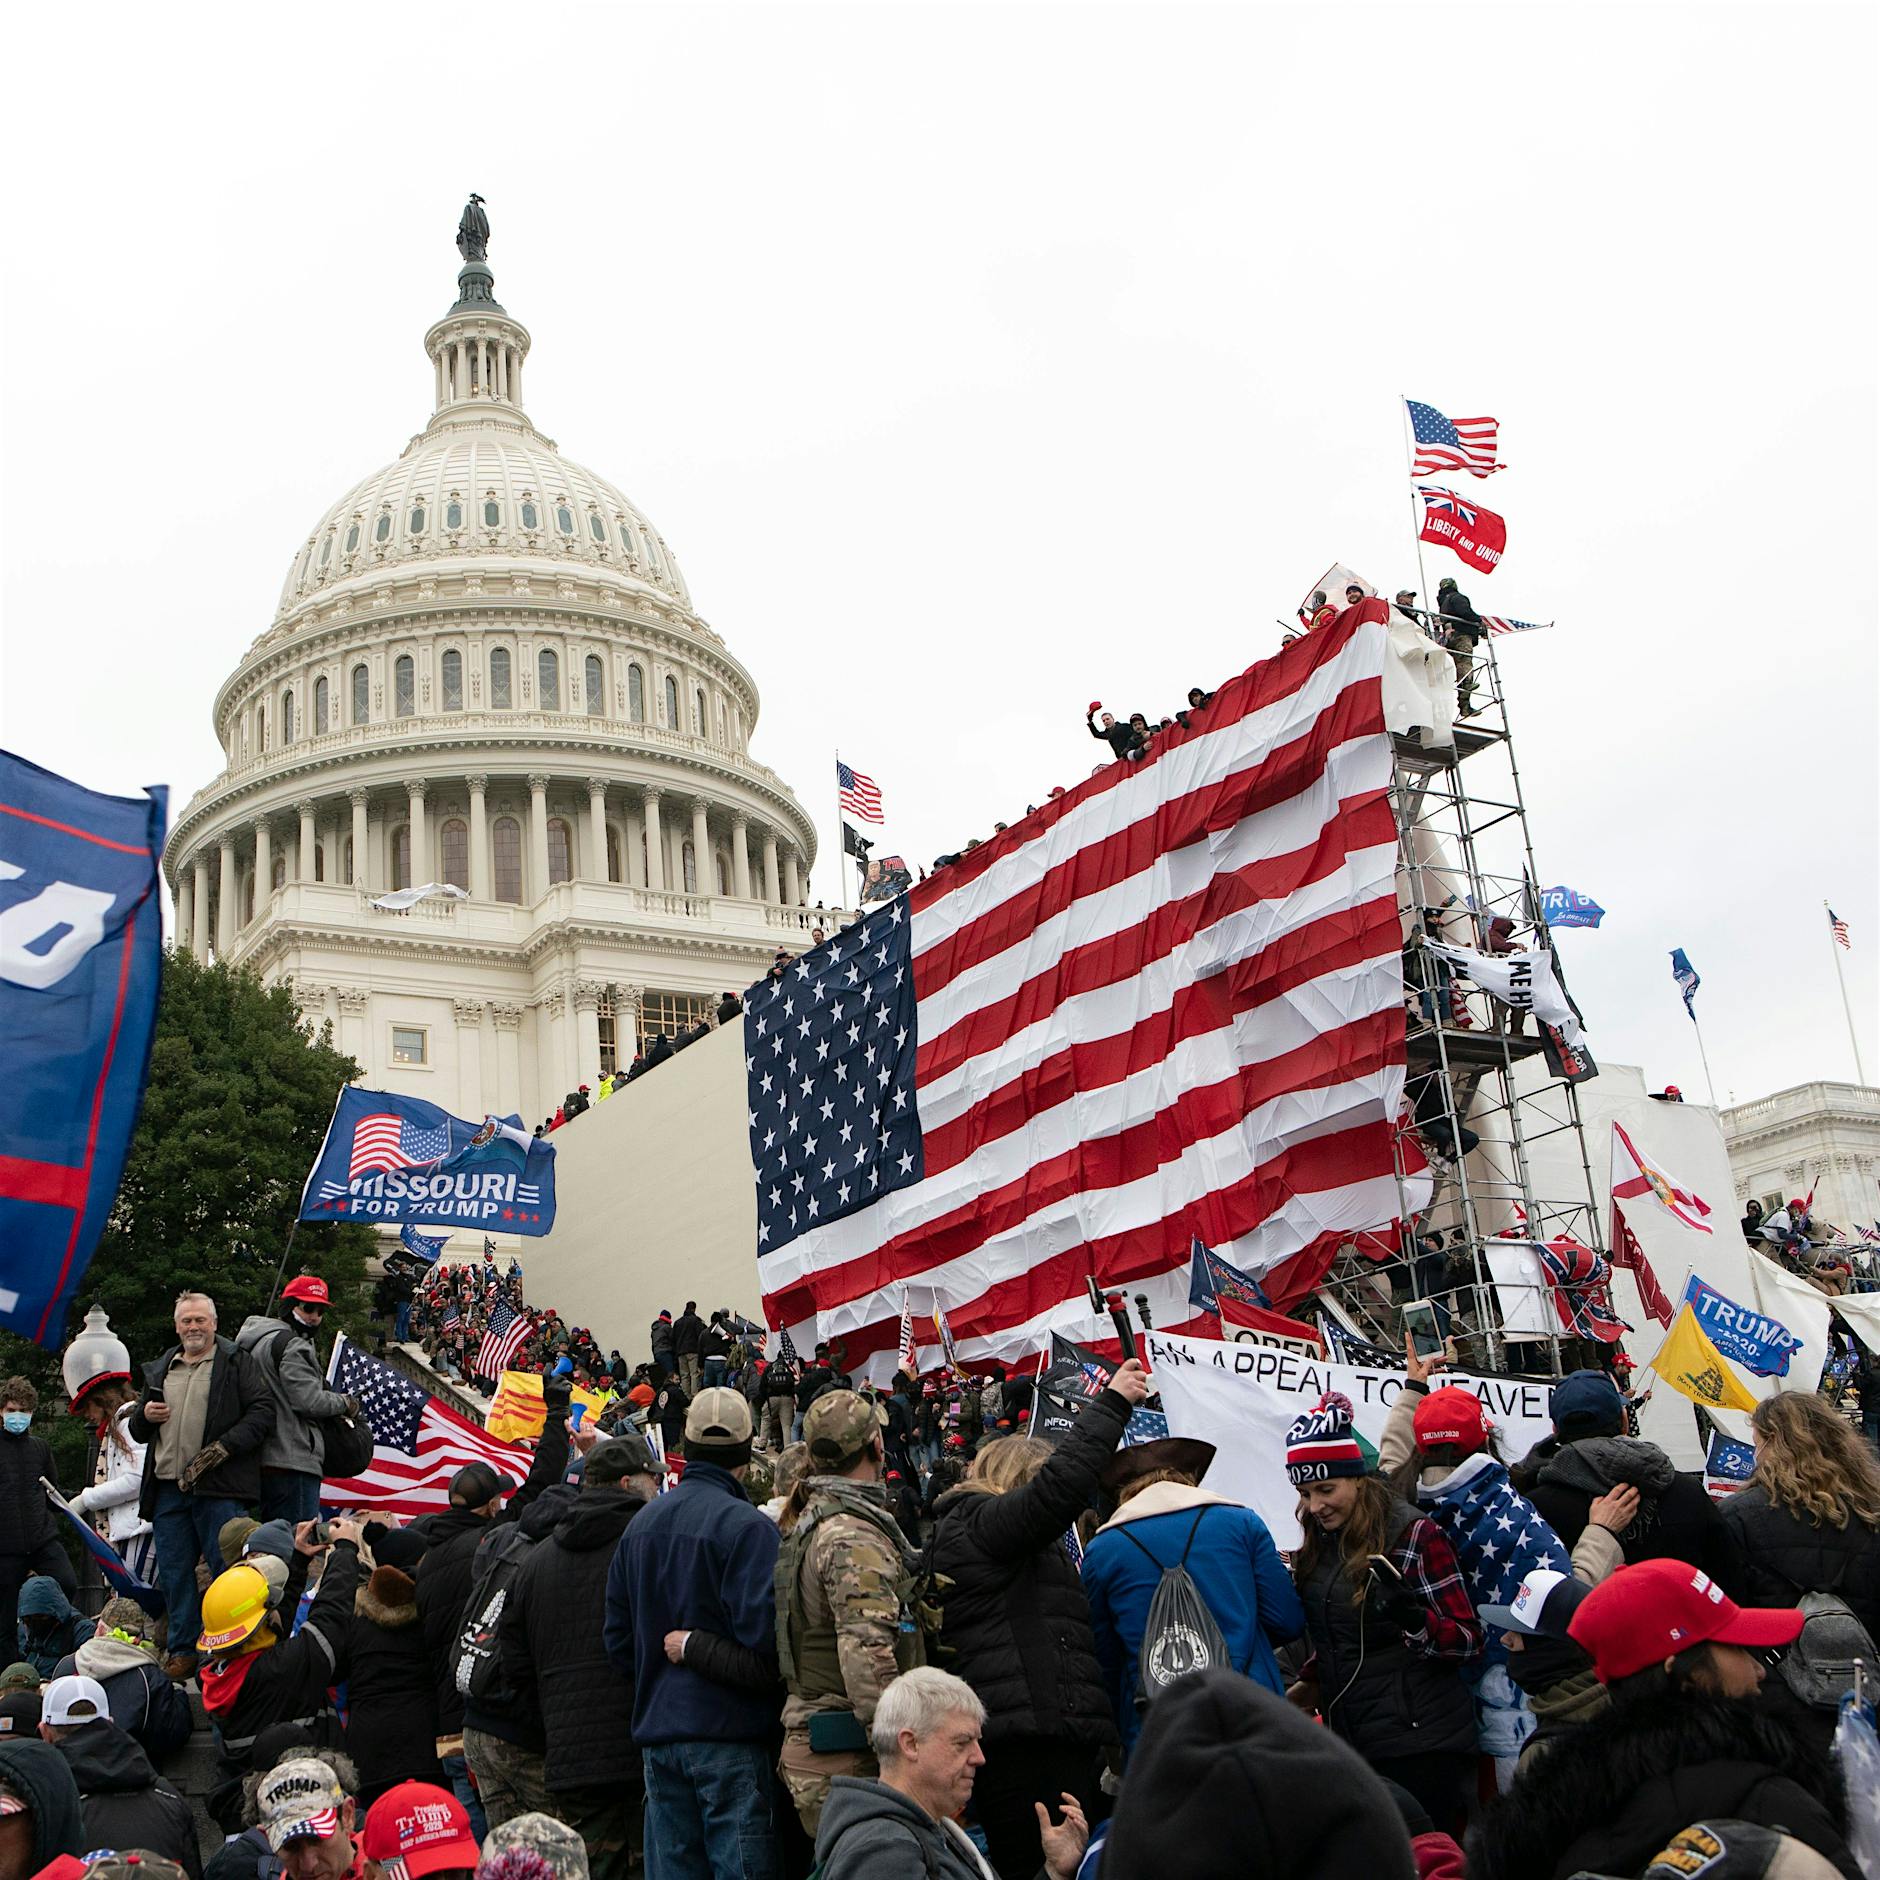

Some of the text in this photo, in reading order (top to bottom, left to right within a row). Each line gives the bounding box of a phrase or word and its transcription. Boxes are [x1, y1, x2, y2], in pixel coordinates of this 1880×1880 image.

[1458, 535, 1475, 551] AND
[1570, 1050, 1587, 1072] FOR
[350, 1199, 499, 1220] FOR TRUMP
[1700, 1292, 1795, 1348] TRUMP
[1149, 1338, 1196, 1366] AN
[206, 1632, 231, 1647] SOVIE
[265, 1778, 321, 1805] TRUMP
[395, 1809, 452, 1833] Trump
[422, 1820, 444, 1833] 2020
